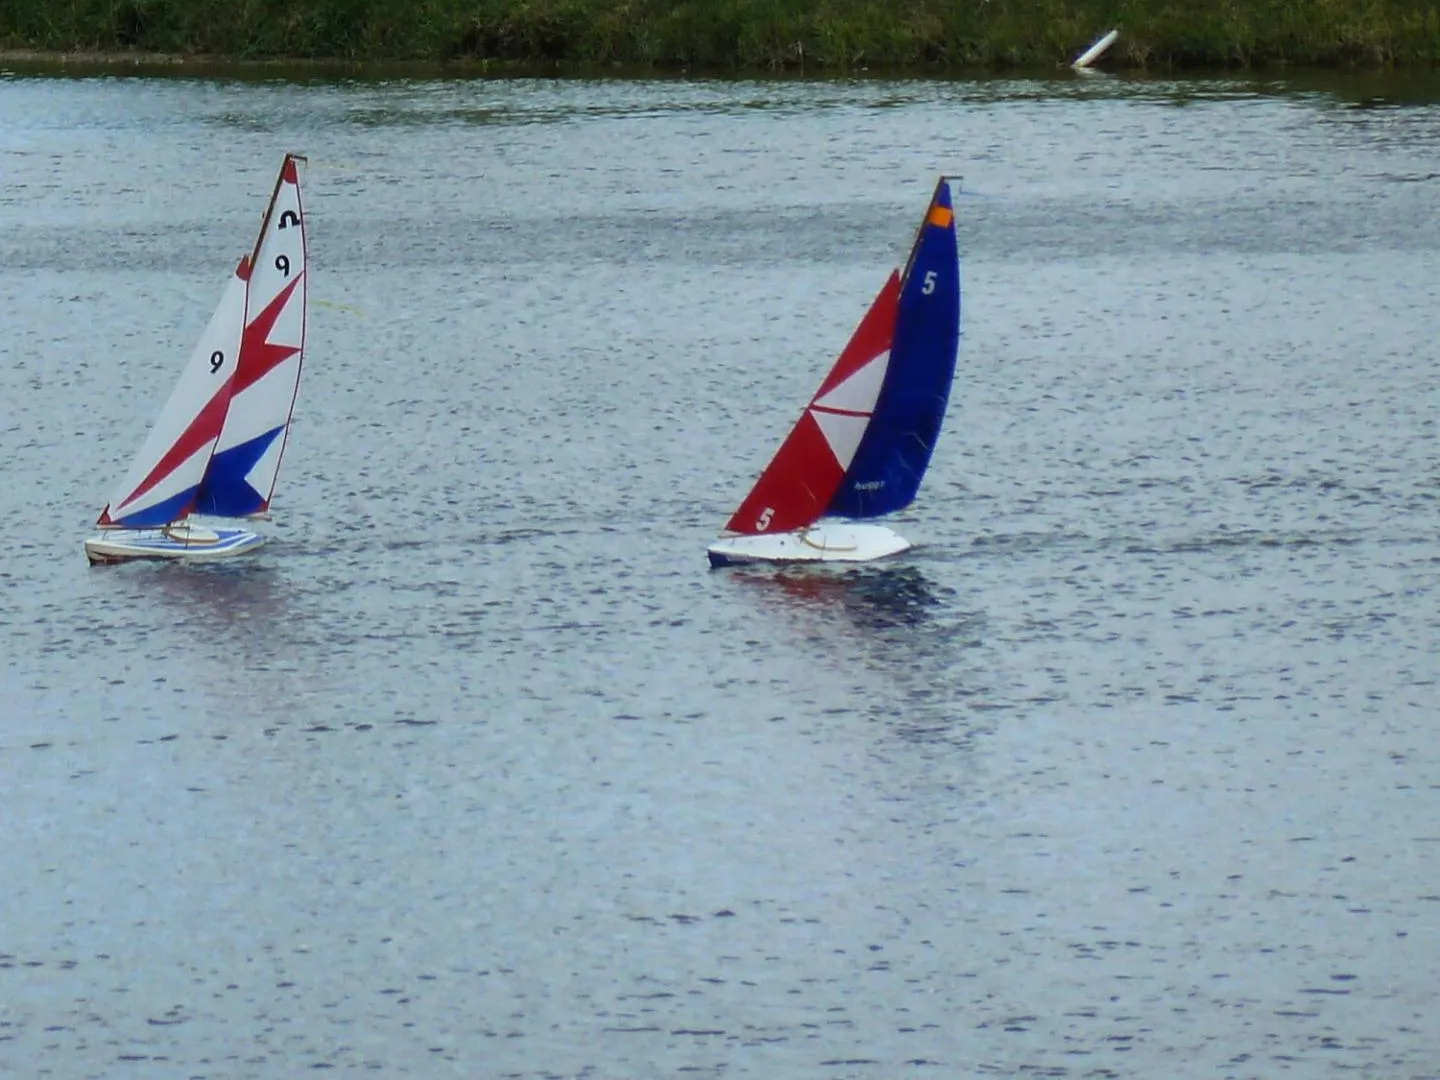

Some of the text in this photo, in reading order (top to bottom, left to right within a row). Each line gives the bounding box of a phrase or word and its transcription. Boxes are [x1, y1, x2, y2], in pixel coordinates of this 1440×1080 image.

[275, 254, 290, 277] 9
[922, 271, 937, 296] 5
[210, 350, 225, 374] 9
[755, 507, 776, 531] 5
